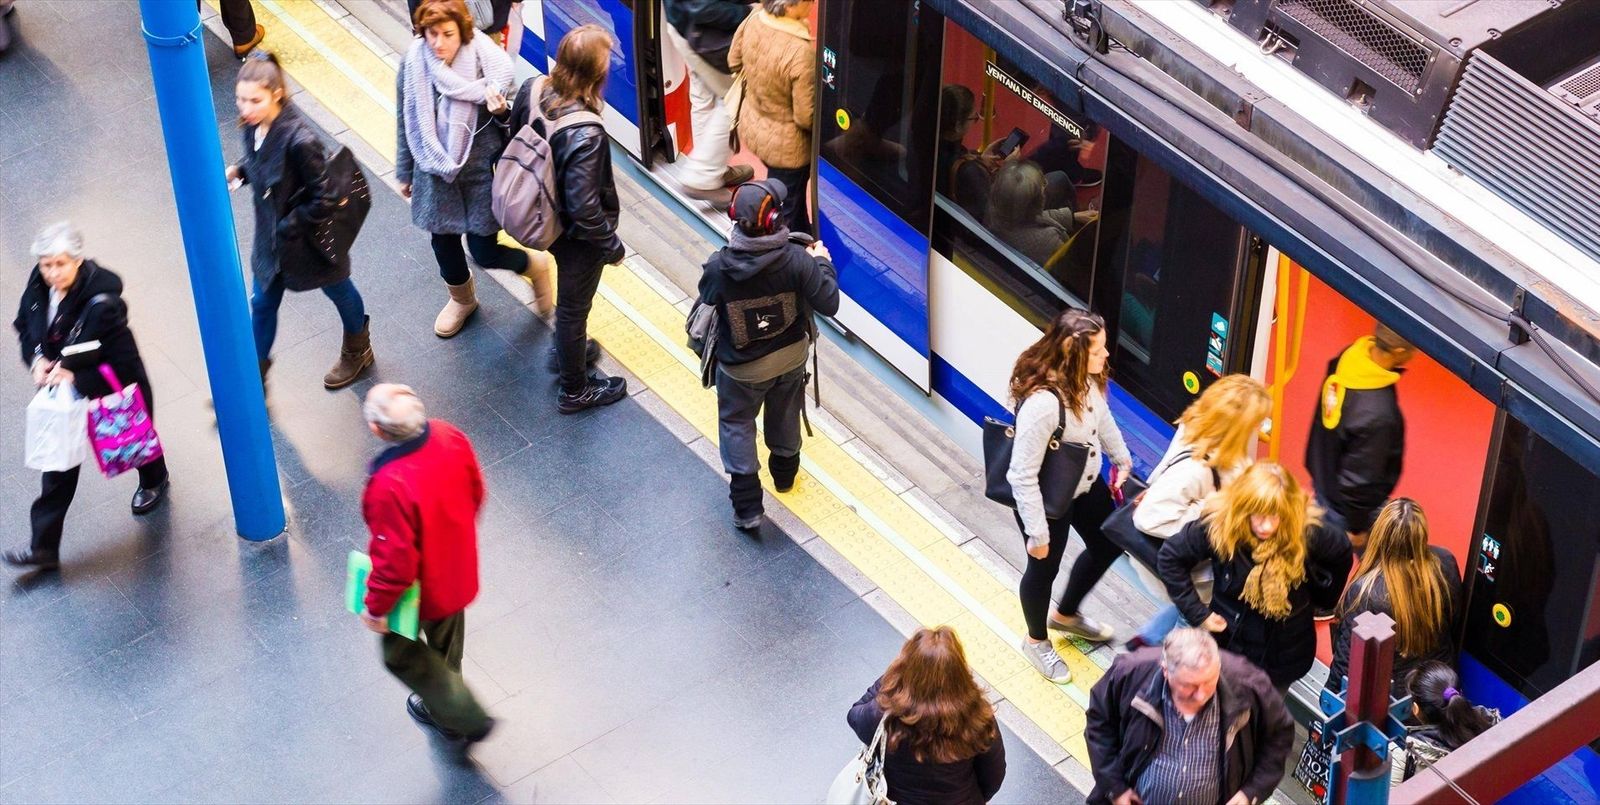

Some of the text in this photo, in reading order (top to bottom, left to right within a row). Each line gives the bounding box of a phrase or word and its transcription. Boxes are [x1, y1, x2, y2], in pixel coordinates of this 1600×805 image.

[987, 64, 1081, 138] VENTANA DE EMERGENCIA
